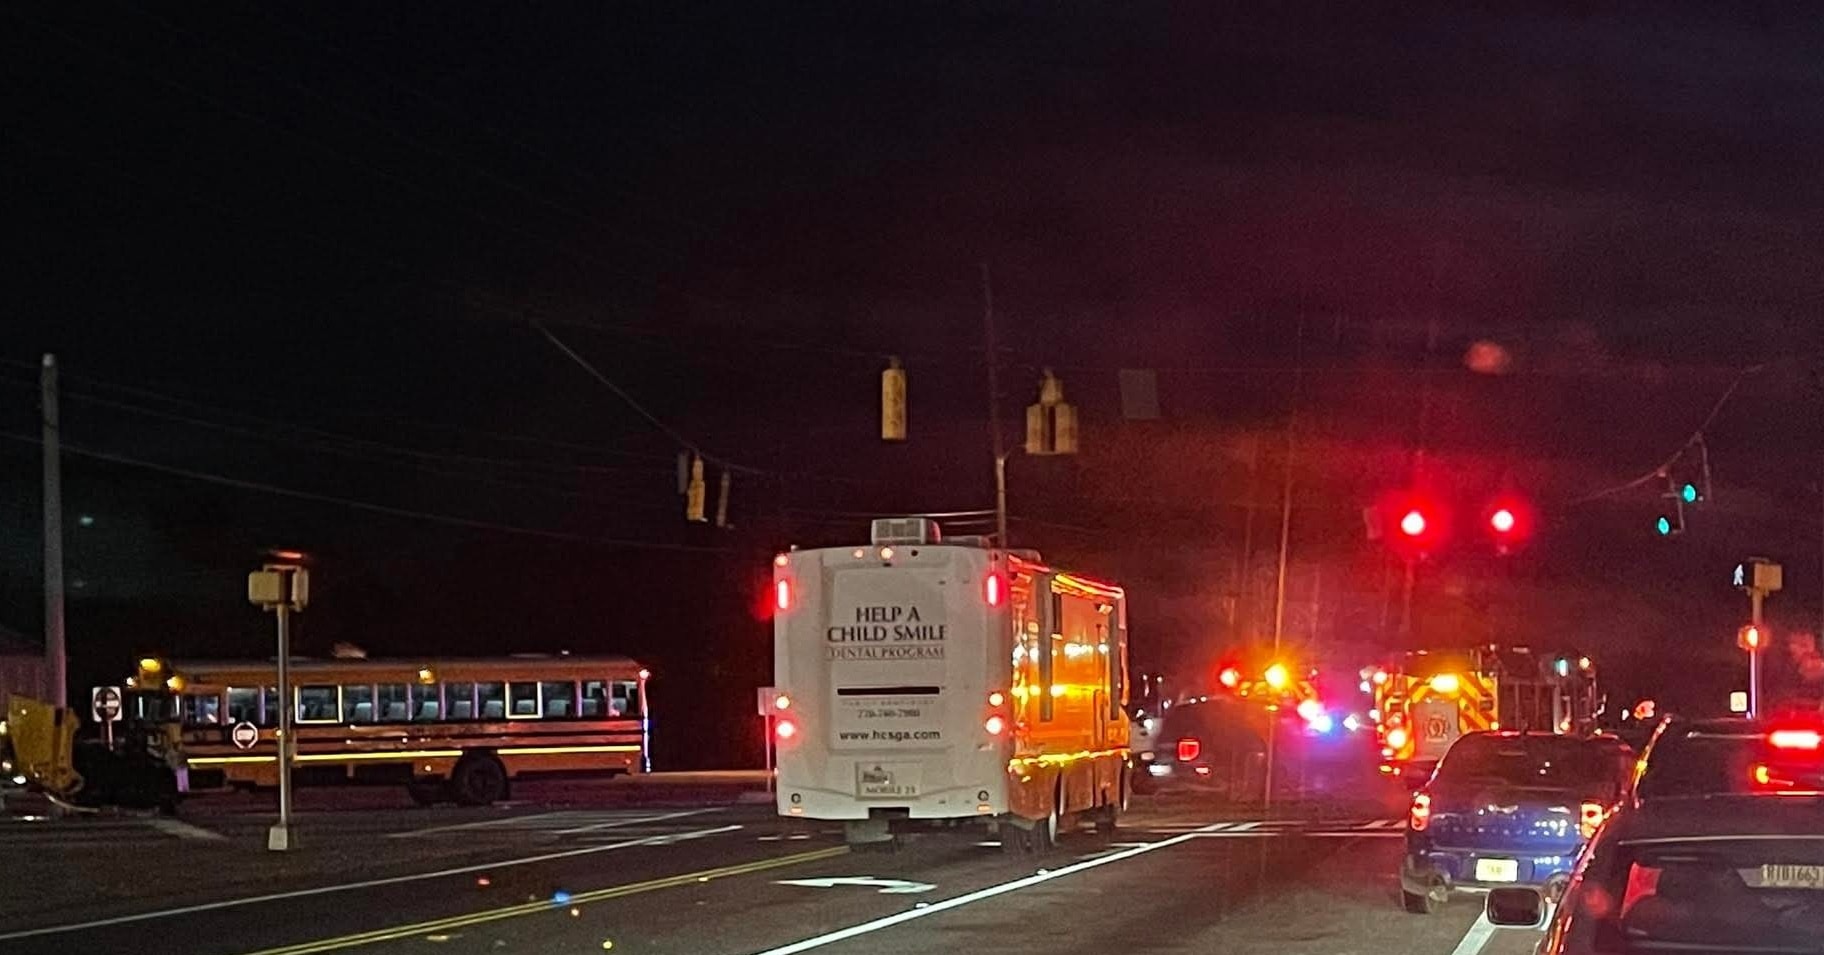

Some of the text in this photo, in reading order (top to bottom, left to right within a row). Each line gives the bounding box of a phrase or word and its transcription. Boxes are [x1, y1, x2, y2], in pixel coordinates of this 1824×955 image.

[856, 606, 920, 622] HELP A
[827, 625, 946, 642] CHILD SMILE
[831, 646, 944, 658] DENTAL PROGRAM
[839, 729, 941, 741] www.hcsga.com
